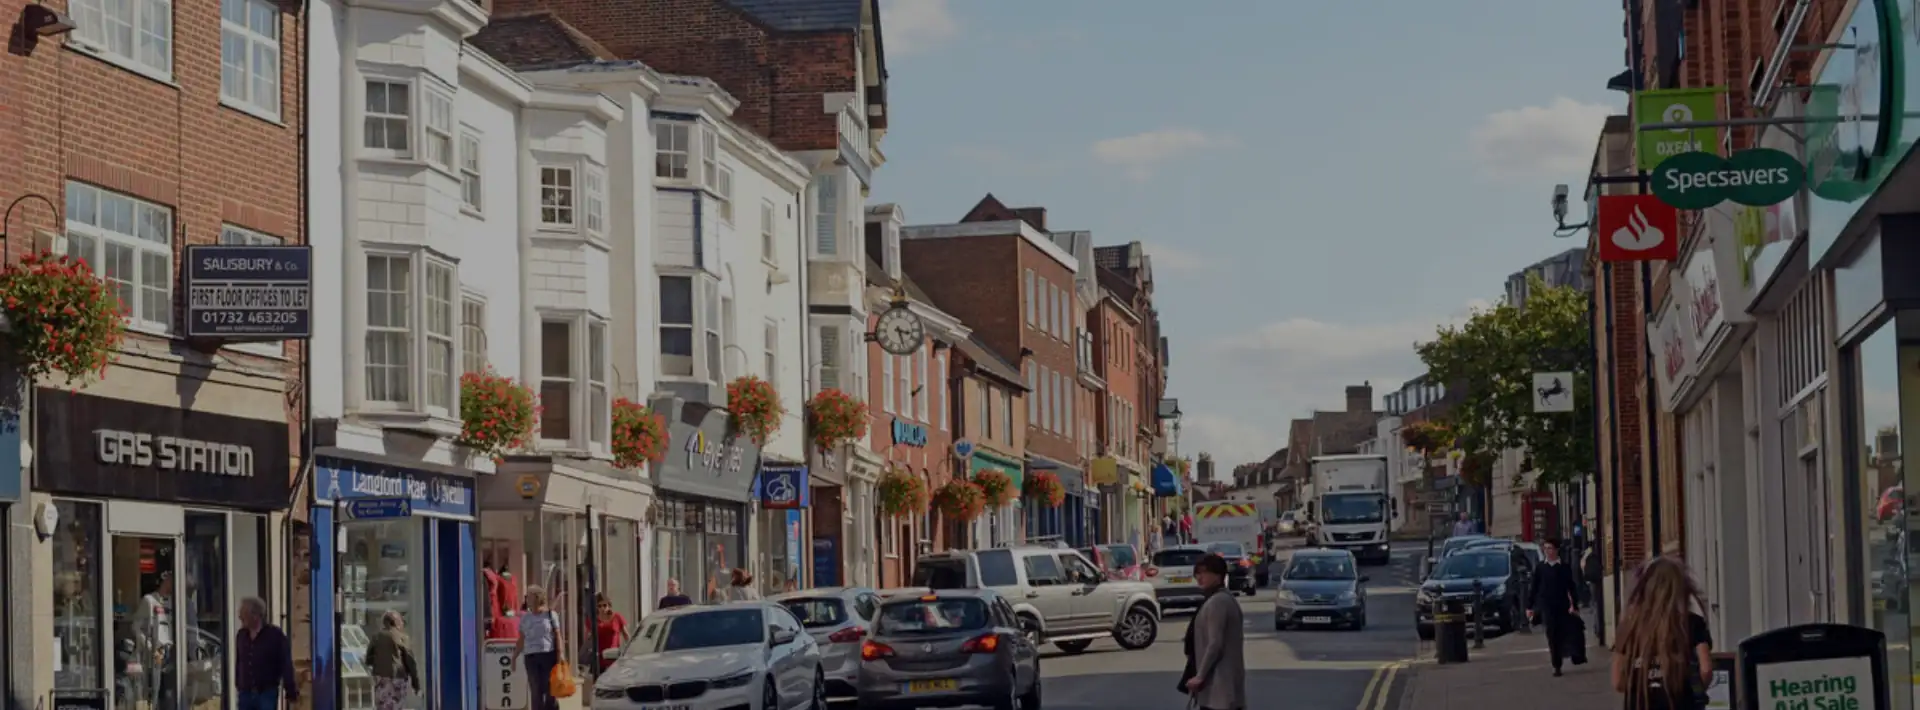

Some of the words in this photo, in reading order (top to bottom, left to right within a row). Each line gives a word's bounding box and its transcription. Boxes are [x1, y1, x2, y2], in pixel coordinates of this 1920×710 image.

[1665, 166, 1789, 193] Specsavers
[203, 257, 273, 271] SALISBURY
[191, 288, 214, 306] FIRST
[216, 288, 242, 306] FLOOR
[245, 288, 279, 307] OFFICES
[280, 289, 292, 307] TO
[293, 289, 307, 307] LET
[202, 312, 243, 324] 01732
[248, 312, 297, 324] 463205
[99, 429, 152, 467] GAS
[157, 436, 254, 477] STATION
[352, 466, 402, 496] Langford
[406, 473, 427, 499] Rae
[499, 655, 511, 708] OPEN
[1770, 674, 1856, 698] Hearing
[1776, 697, 1808, 710] Aid
[1814, 694, 1859, 710] Sale
